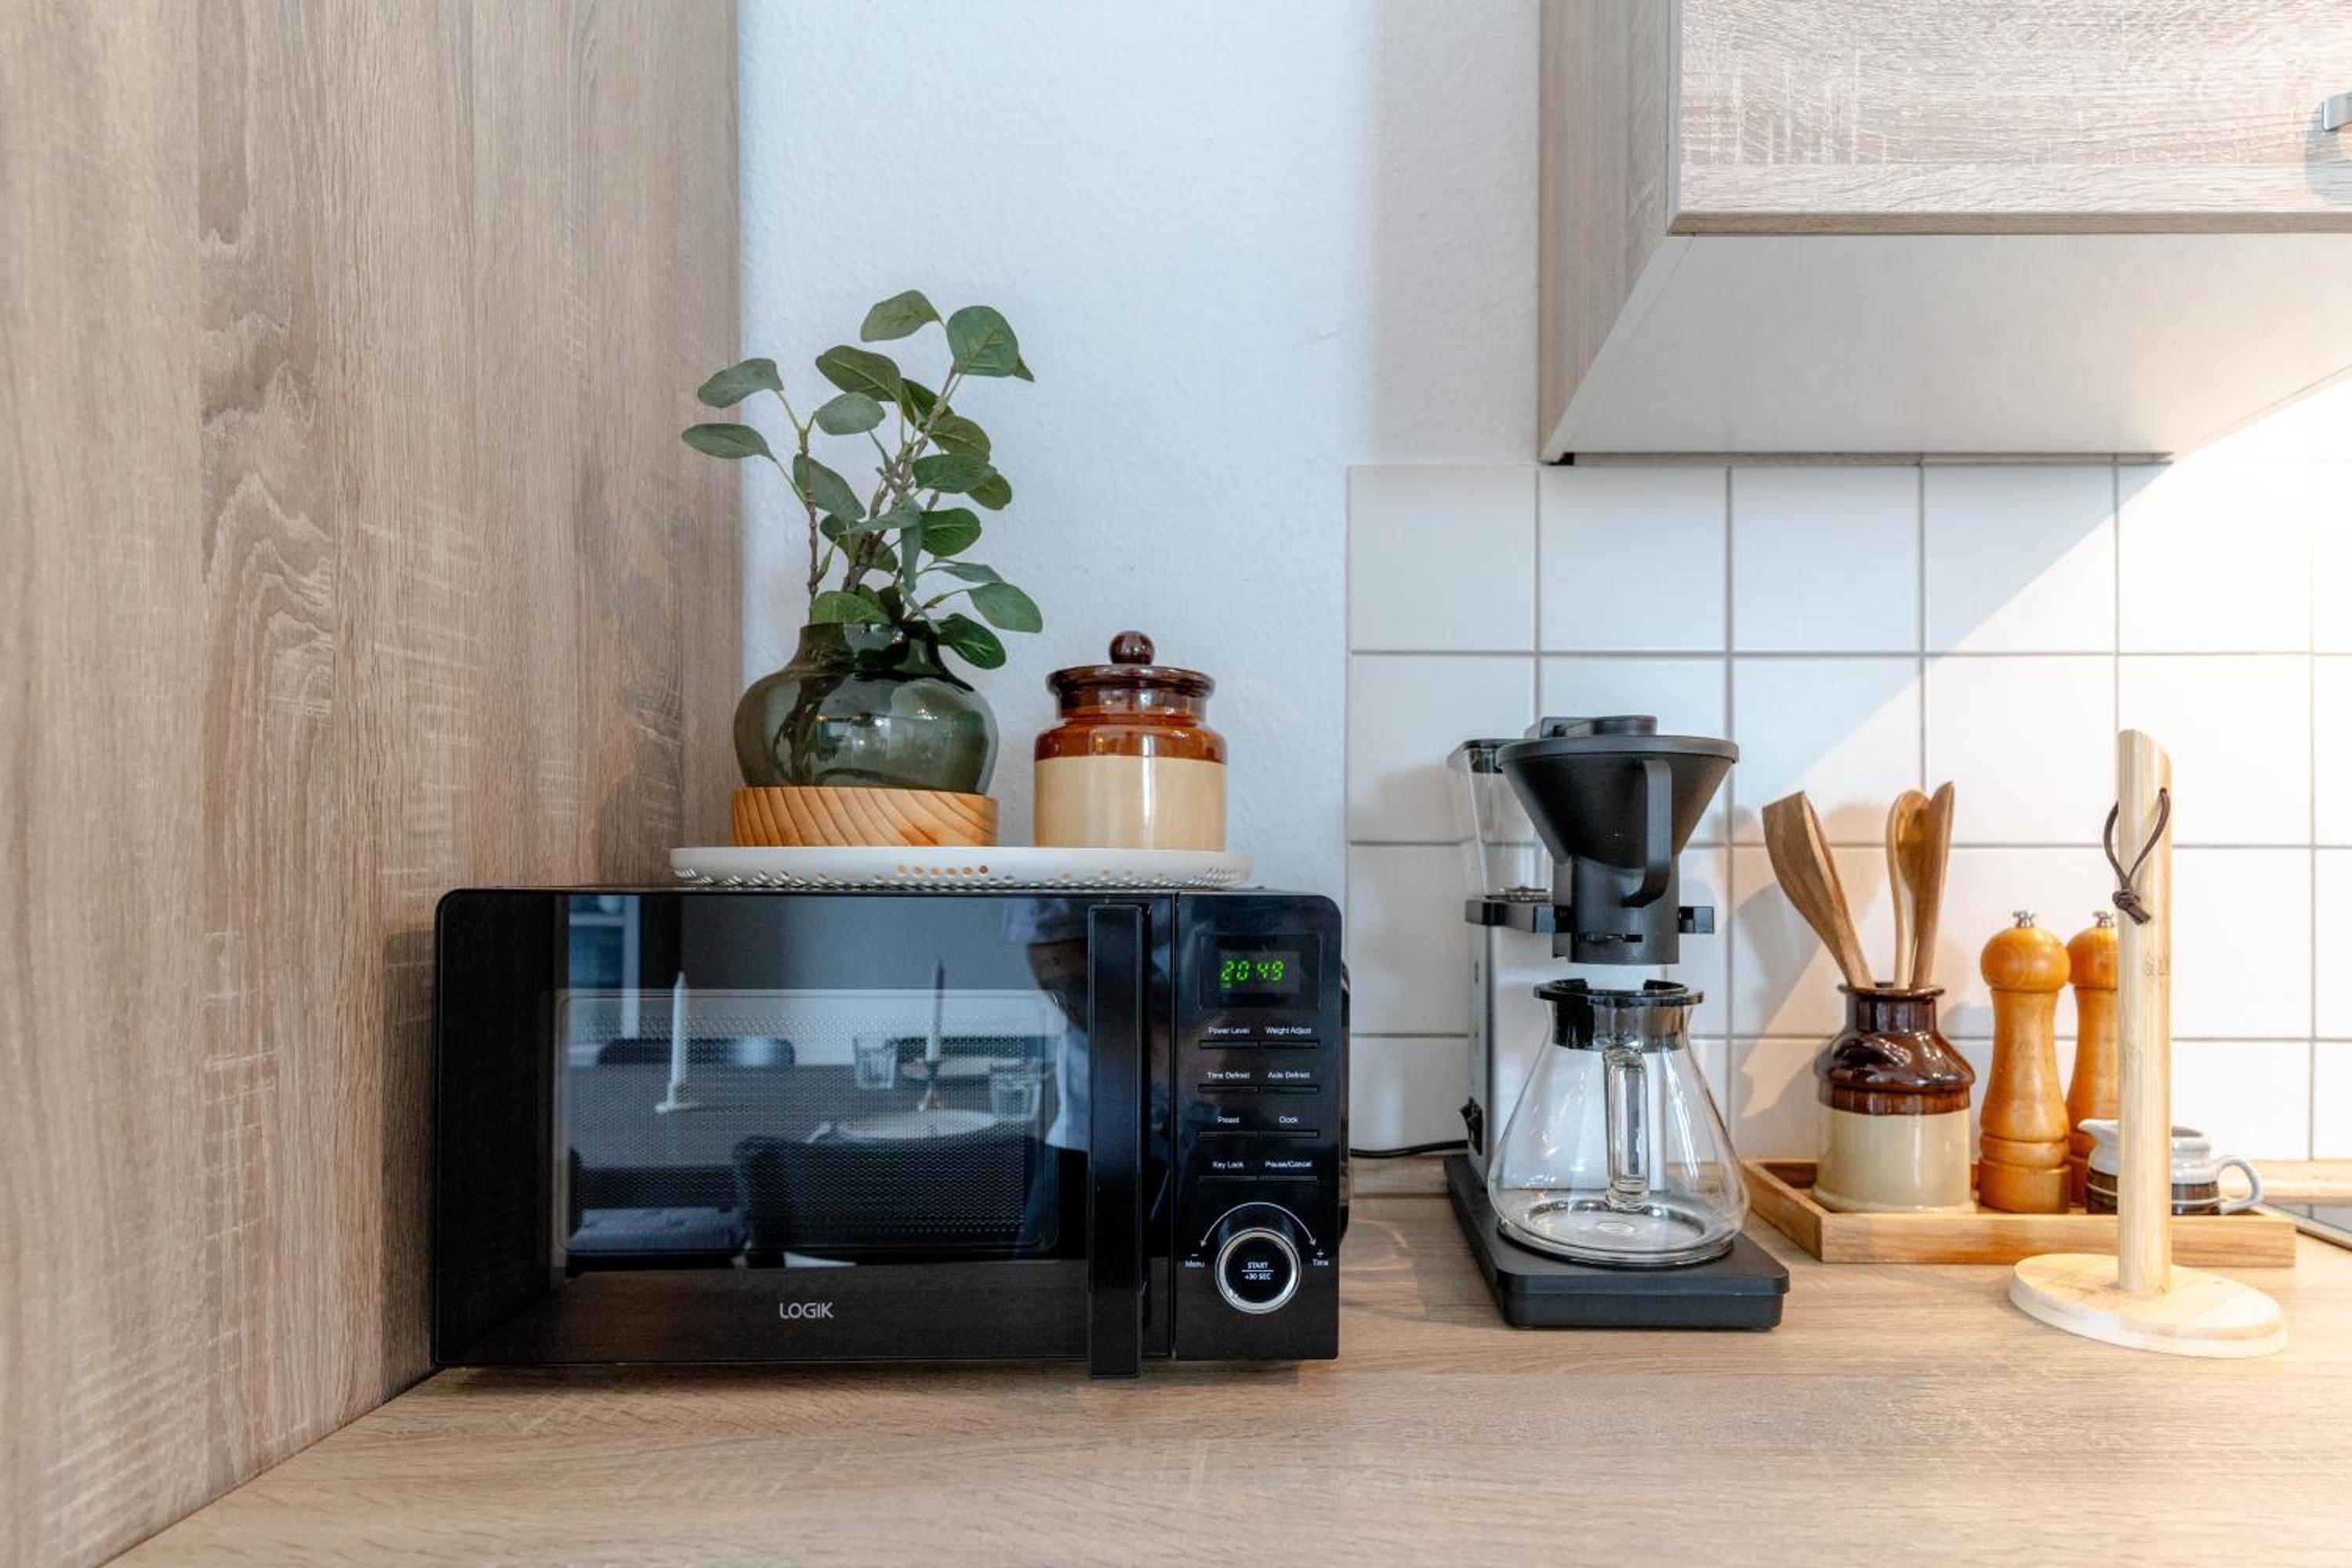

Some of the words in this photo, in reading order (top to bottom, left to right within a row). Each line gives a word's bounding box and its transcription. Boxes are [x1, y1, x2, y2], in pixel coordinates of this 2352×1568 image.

[1265, 1026, 1289, 1036] Weight
[1290, 1026, 1312, 1035] Adjust
[1218, 1116, 1239, 1124] Preset
[1279, 1116, 1298, 1124] Clock
[1212, 1160, 1226, 1170] Key
[780, 1303, 833, 1318] LOGIK
